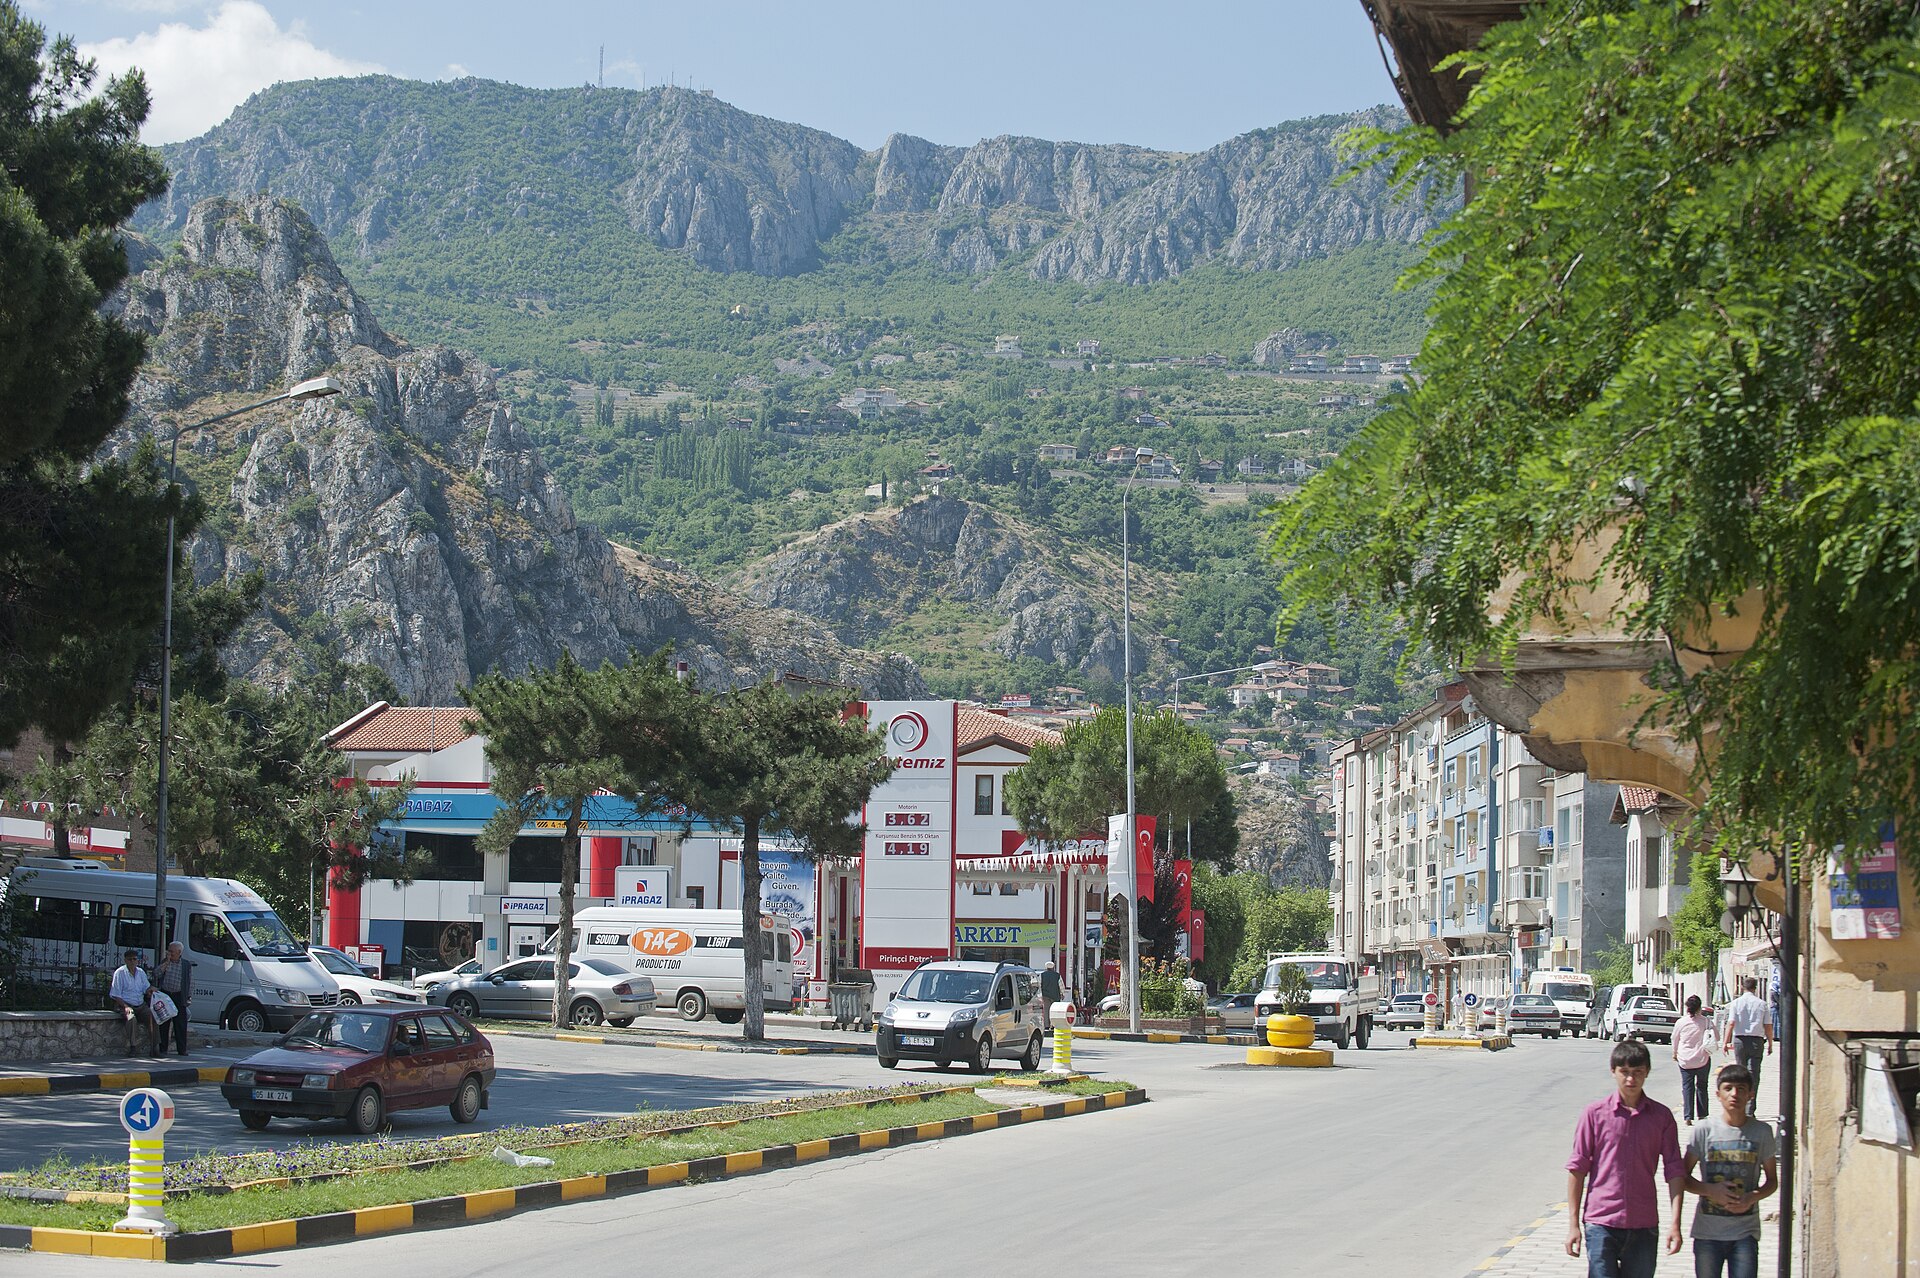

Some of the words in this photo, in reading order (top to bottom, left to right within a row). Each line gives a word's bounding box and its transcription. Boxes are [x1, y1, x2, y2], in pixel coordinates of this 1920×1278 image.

[879, 756, 946, 769] temiz
[398, 800, 453, 813] PRAGAZ
[888, 814, 929, 825] 3,62
[888, 843, 928, 855] 4,19
[595, 934, 619, 944] SOUND
[954, 926, 1022, 943] ARKET
[643, 932, 679, 953] TAÇ
[707, 936, 732, 947] LIGHT
[635, 959, 682, 969] PRODUCTION
[880, 955, 907, 964] Pirinçci
